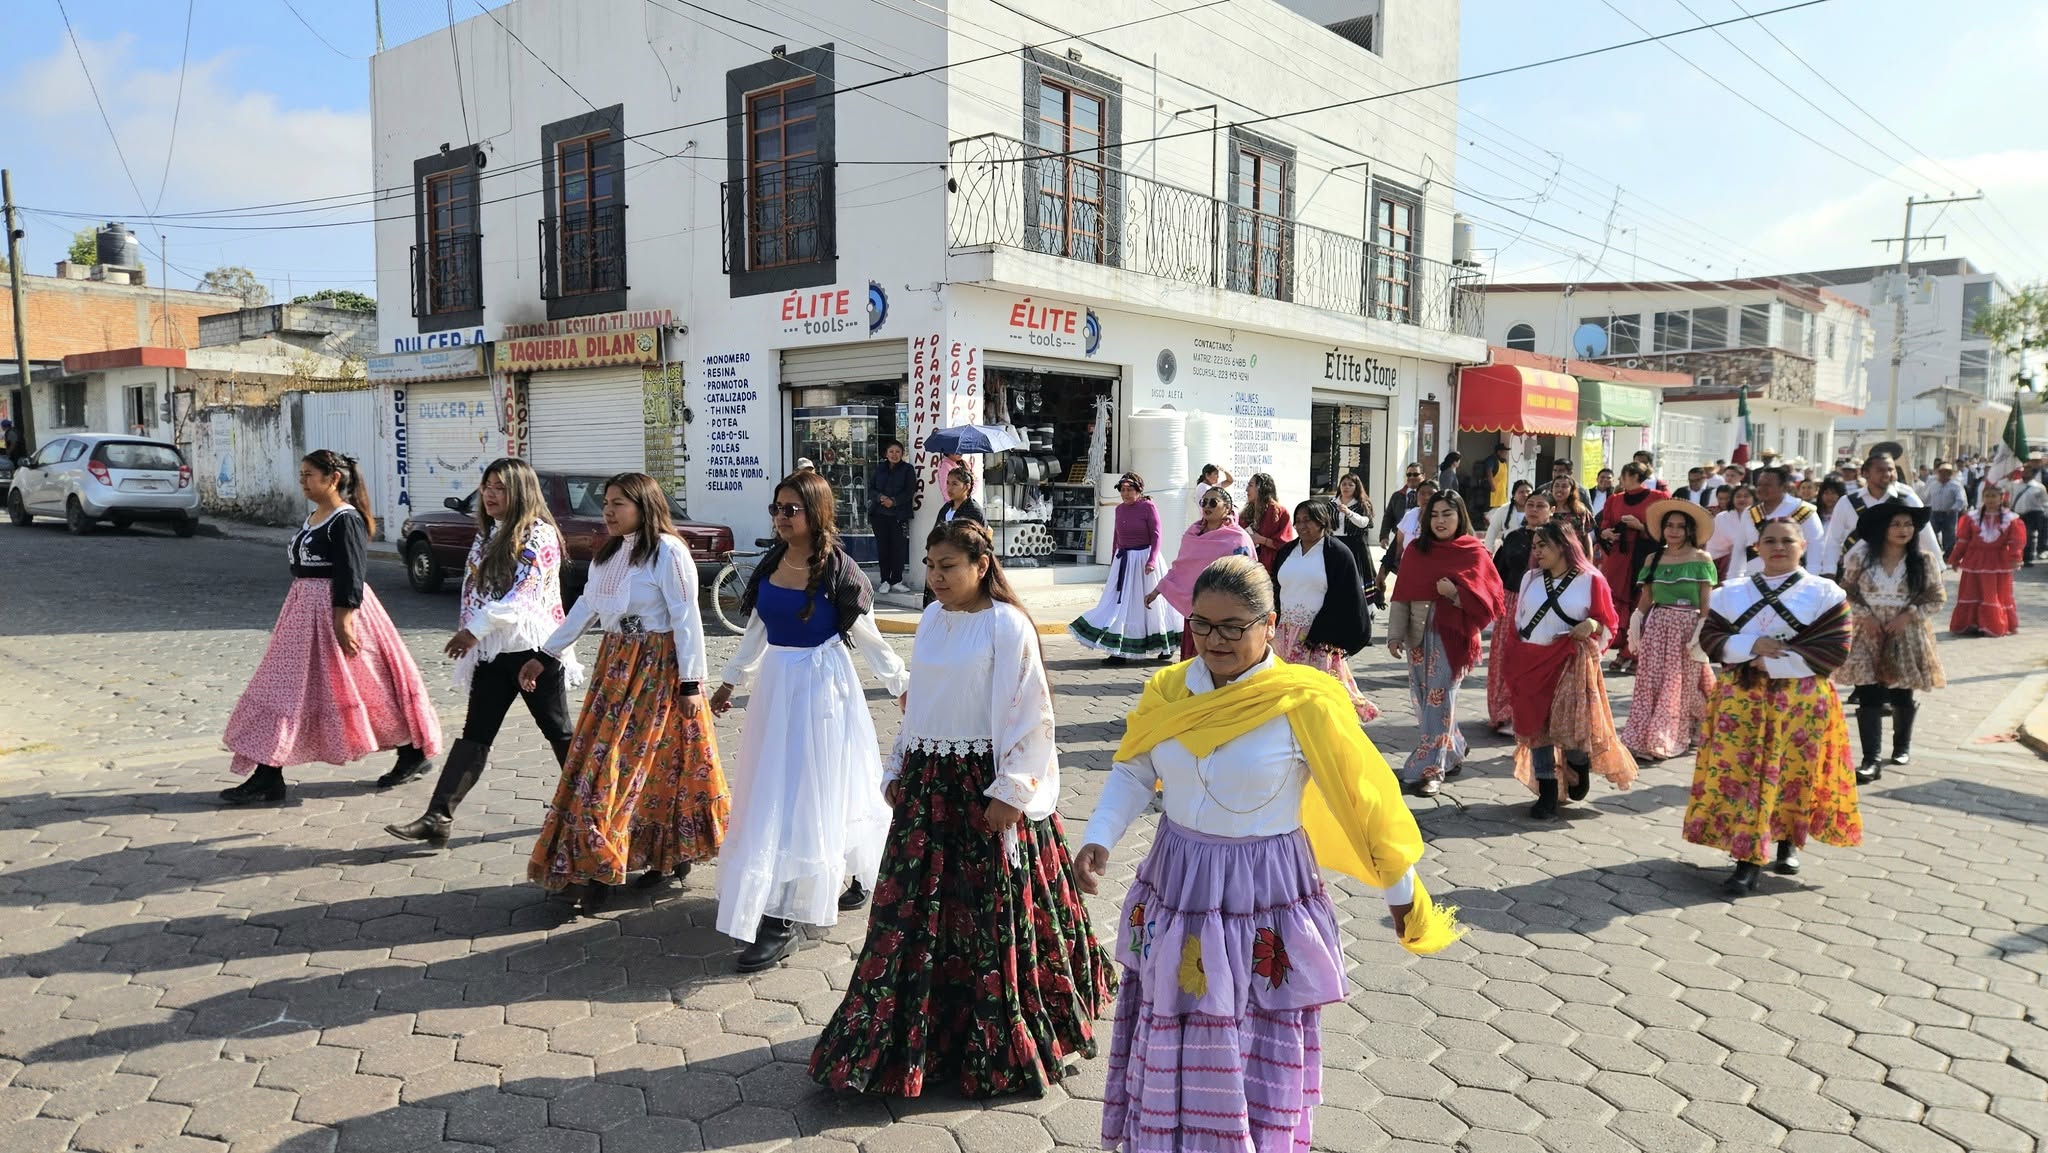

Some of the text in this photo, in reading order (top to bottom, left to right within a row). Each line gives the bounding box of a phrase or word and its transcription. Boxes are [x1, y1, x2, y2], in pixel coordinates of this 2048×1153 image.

[782, 290, 850, 321] ÉLITE
[1009, 297, 1077, 334] ÉLITE
[804, 318, 844, 335] tools
[1029, 331, 1062, 347] tools
[509, 333, 636, 362] TAQUERIA DILAN
[706, 352, 750, 365] MONOMERO
[707, 366, 736, 378] RESINA
[1324, 346, 1397, 391] Élite Stone
[707, 378, 749, 390] PROMOTOR
[706, 391, 757, 403] CATALIZADOR
[710, 404, 746, 415] THINNER
[711, 418, 738, 428] POTEA
[913, 334, 942, 512] HERRAMIENTAS DIAMANTAS
[394, 390, 410, 506] DULCERIA
[711, 443, 740, 453] POLEAS
[708, 468, 764, 479] FIBRA DE VIDRIO
[707, 481, 743, 491] SELLADOR
